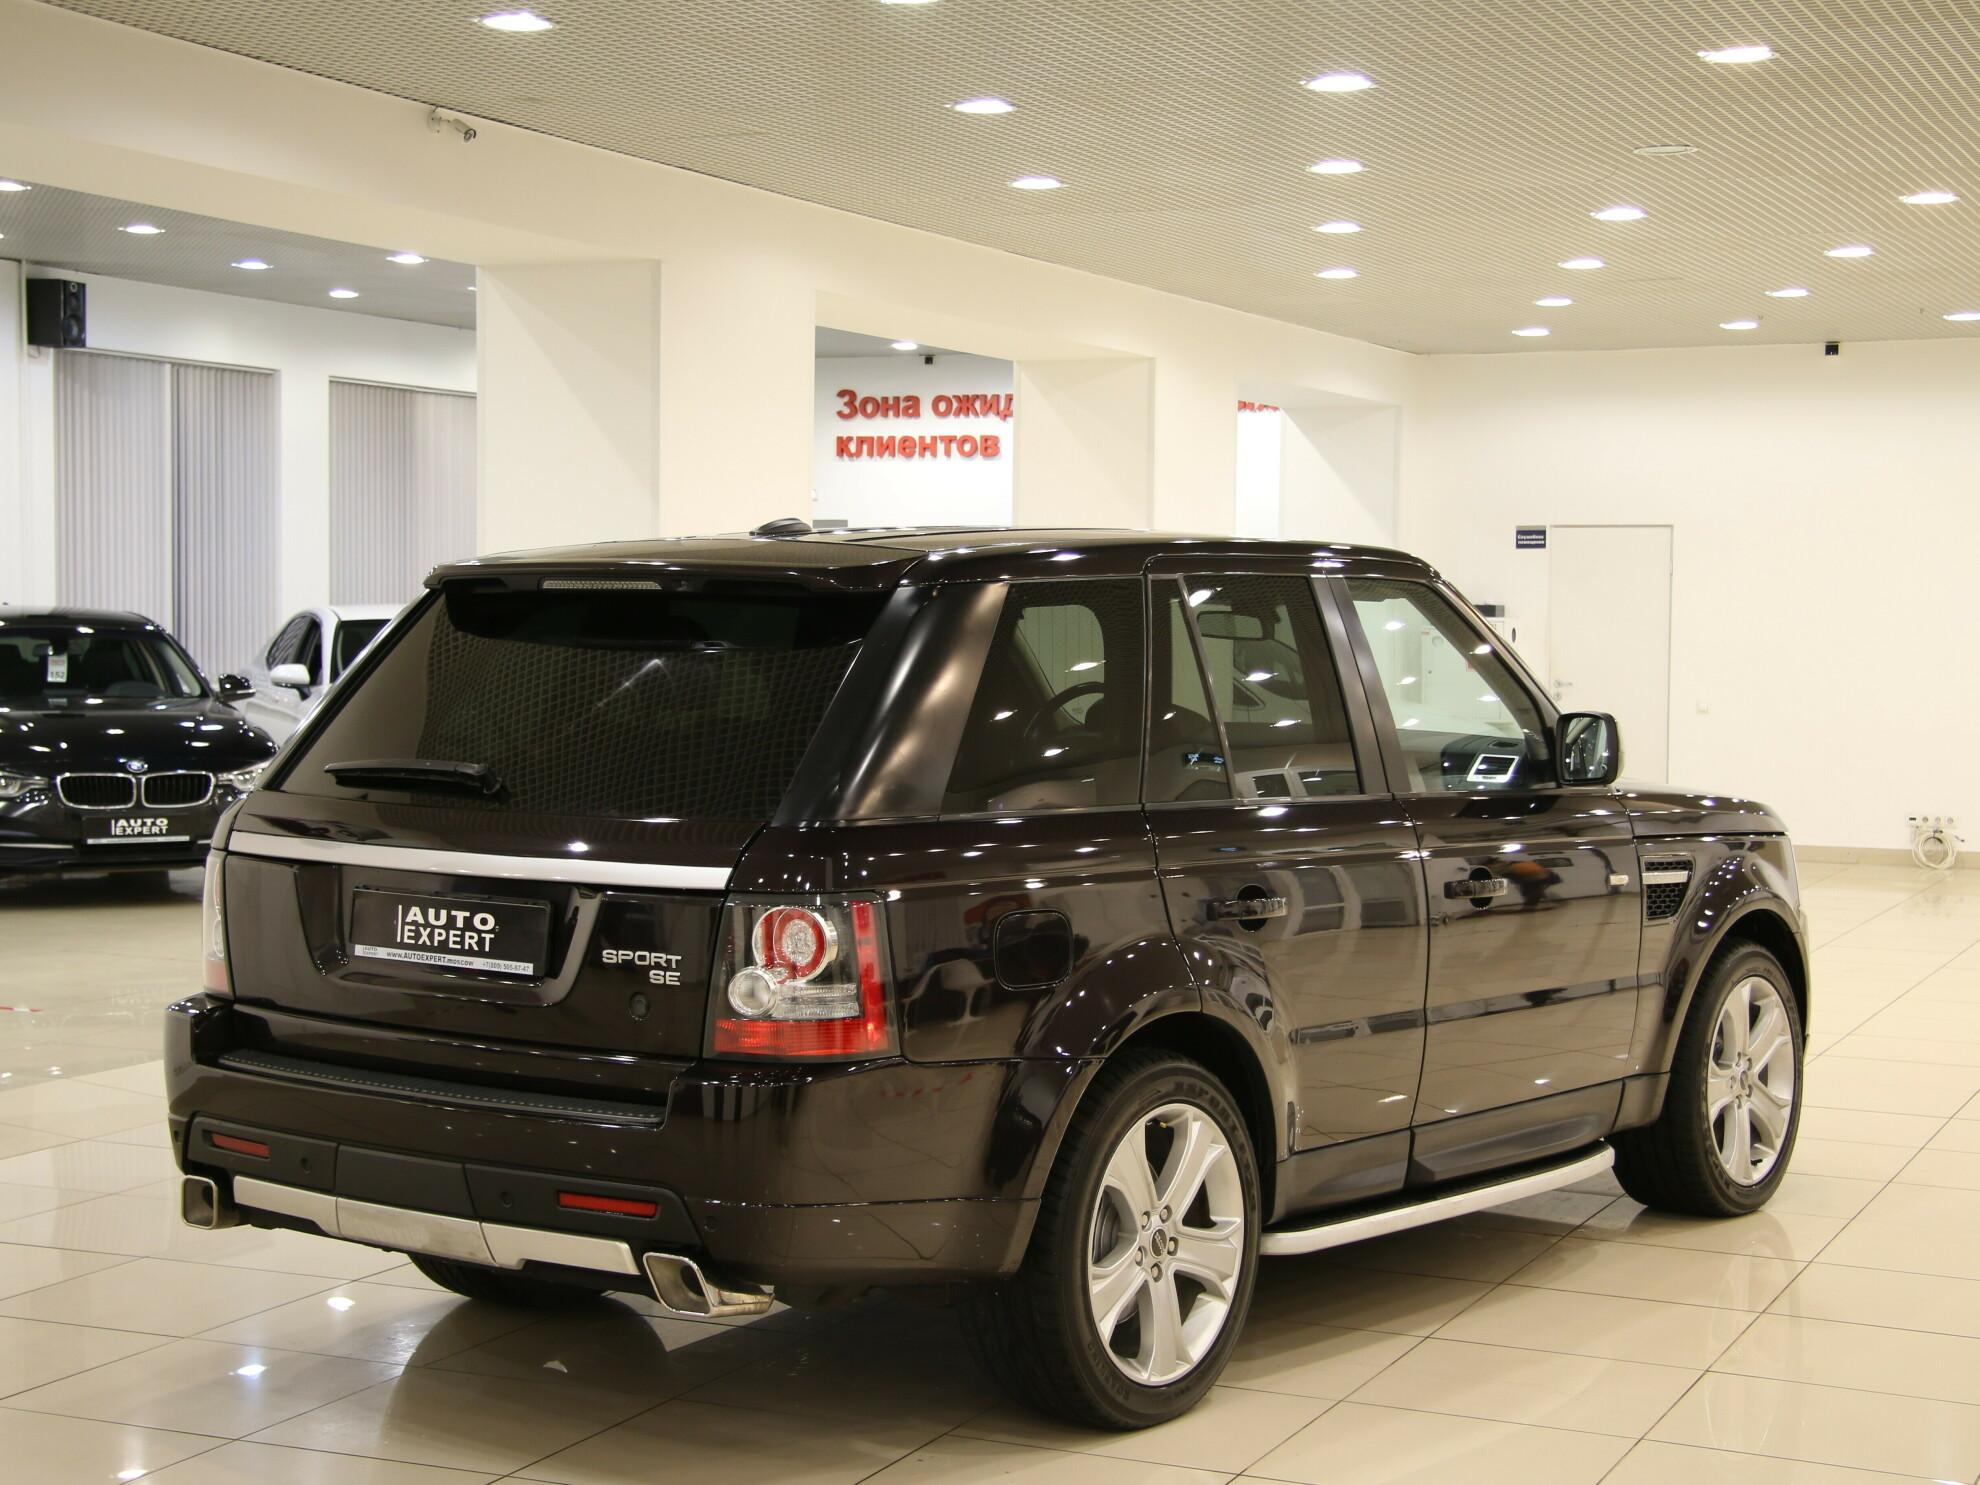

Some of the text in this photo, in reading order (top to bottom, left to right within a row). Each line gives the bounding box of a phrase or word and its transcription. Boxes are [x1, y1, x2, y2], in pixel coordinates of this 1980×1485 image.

[836, 389, 921, 420] Зона
[836, 434, 1001, 459] клиентов
[115, 825, 169, 836] EXPERT
[116, 818, 169, 827] AUTO
[405, 906, 496, 931] AUTO
[403, 925, 495, 952] EXPERT
[602, 949, 682, 969] SPORT
[649, 969, 681, 985] SE
